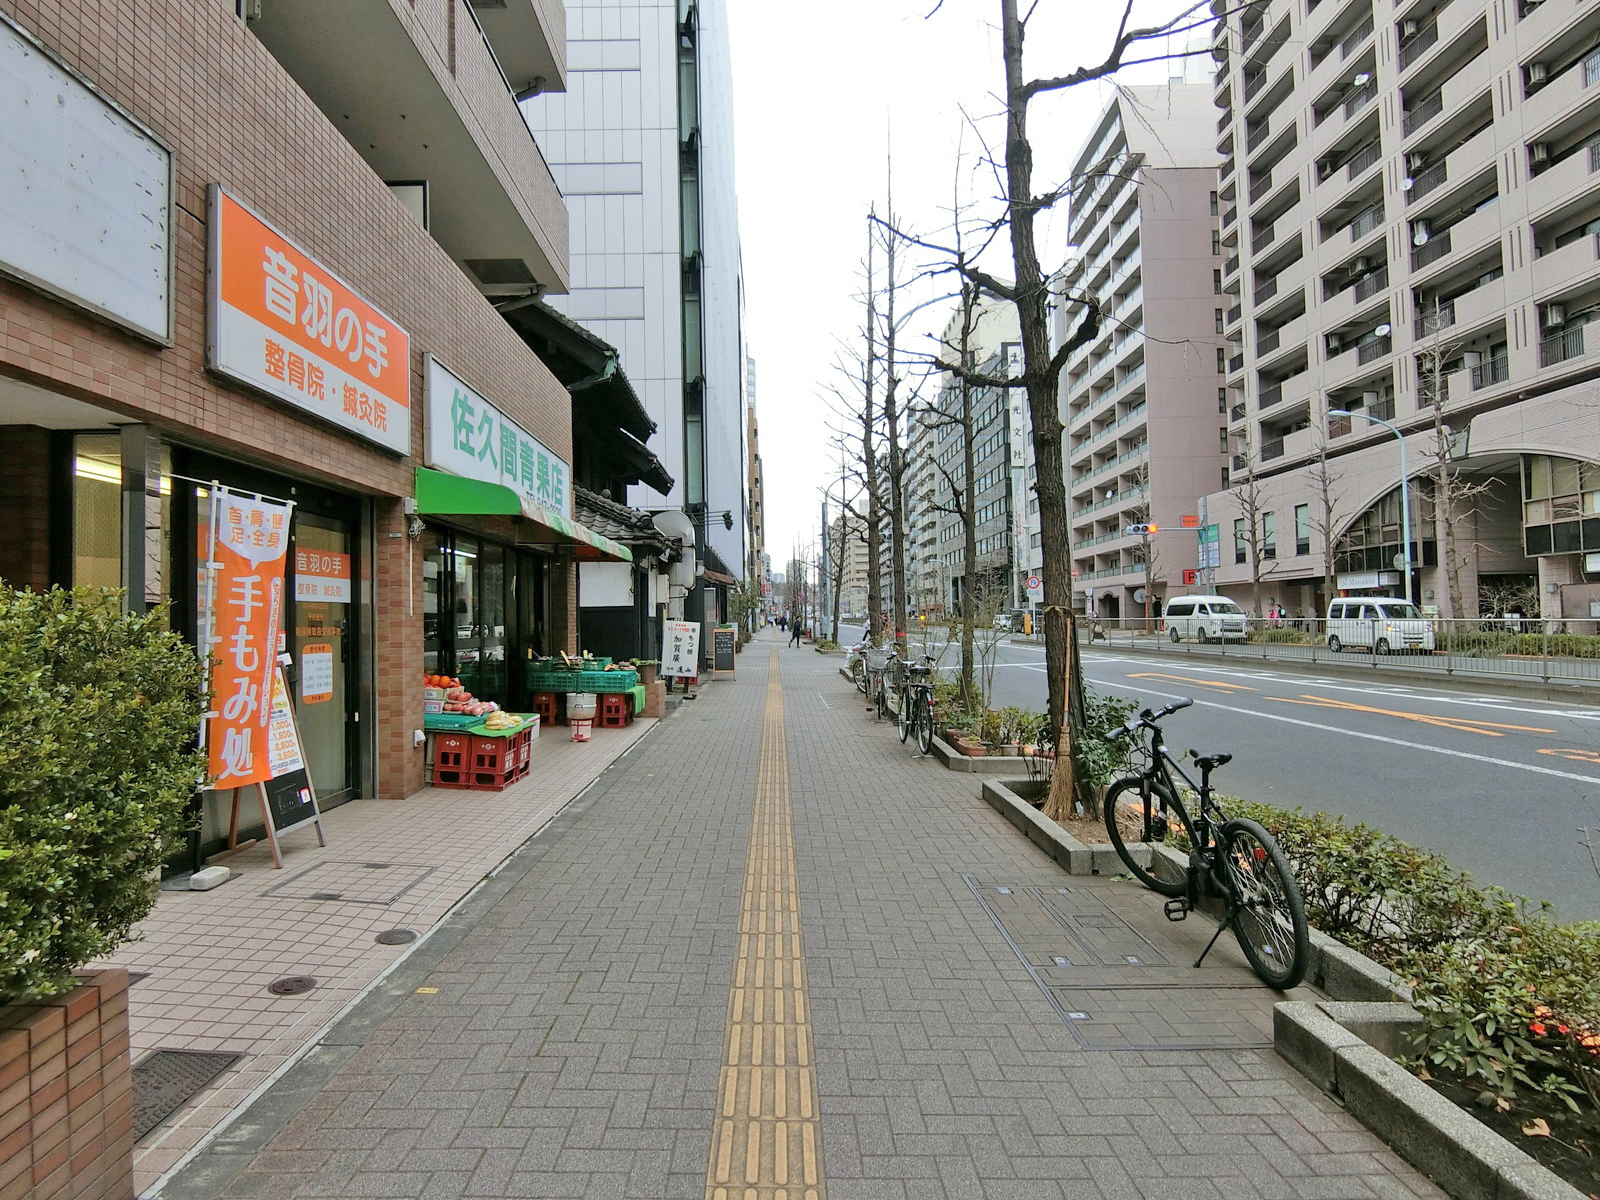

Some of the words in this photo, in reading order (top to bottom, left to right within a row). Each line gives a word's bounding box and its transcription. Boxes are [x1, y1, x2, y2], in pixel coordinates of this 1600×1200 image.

[262, 246, 388, 378] 音羽の手
[265, 338, 387, 432] 整骨院・鍼灸院
[1012, 405, 1022, 459] 光文社
[451, 387, 563, 508] 佐久間青果店
[297, 552, 342, 574] 音羽の手
[219, 574, 264, 779] 手もみ処
